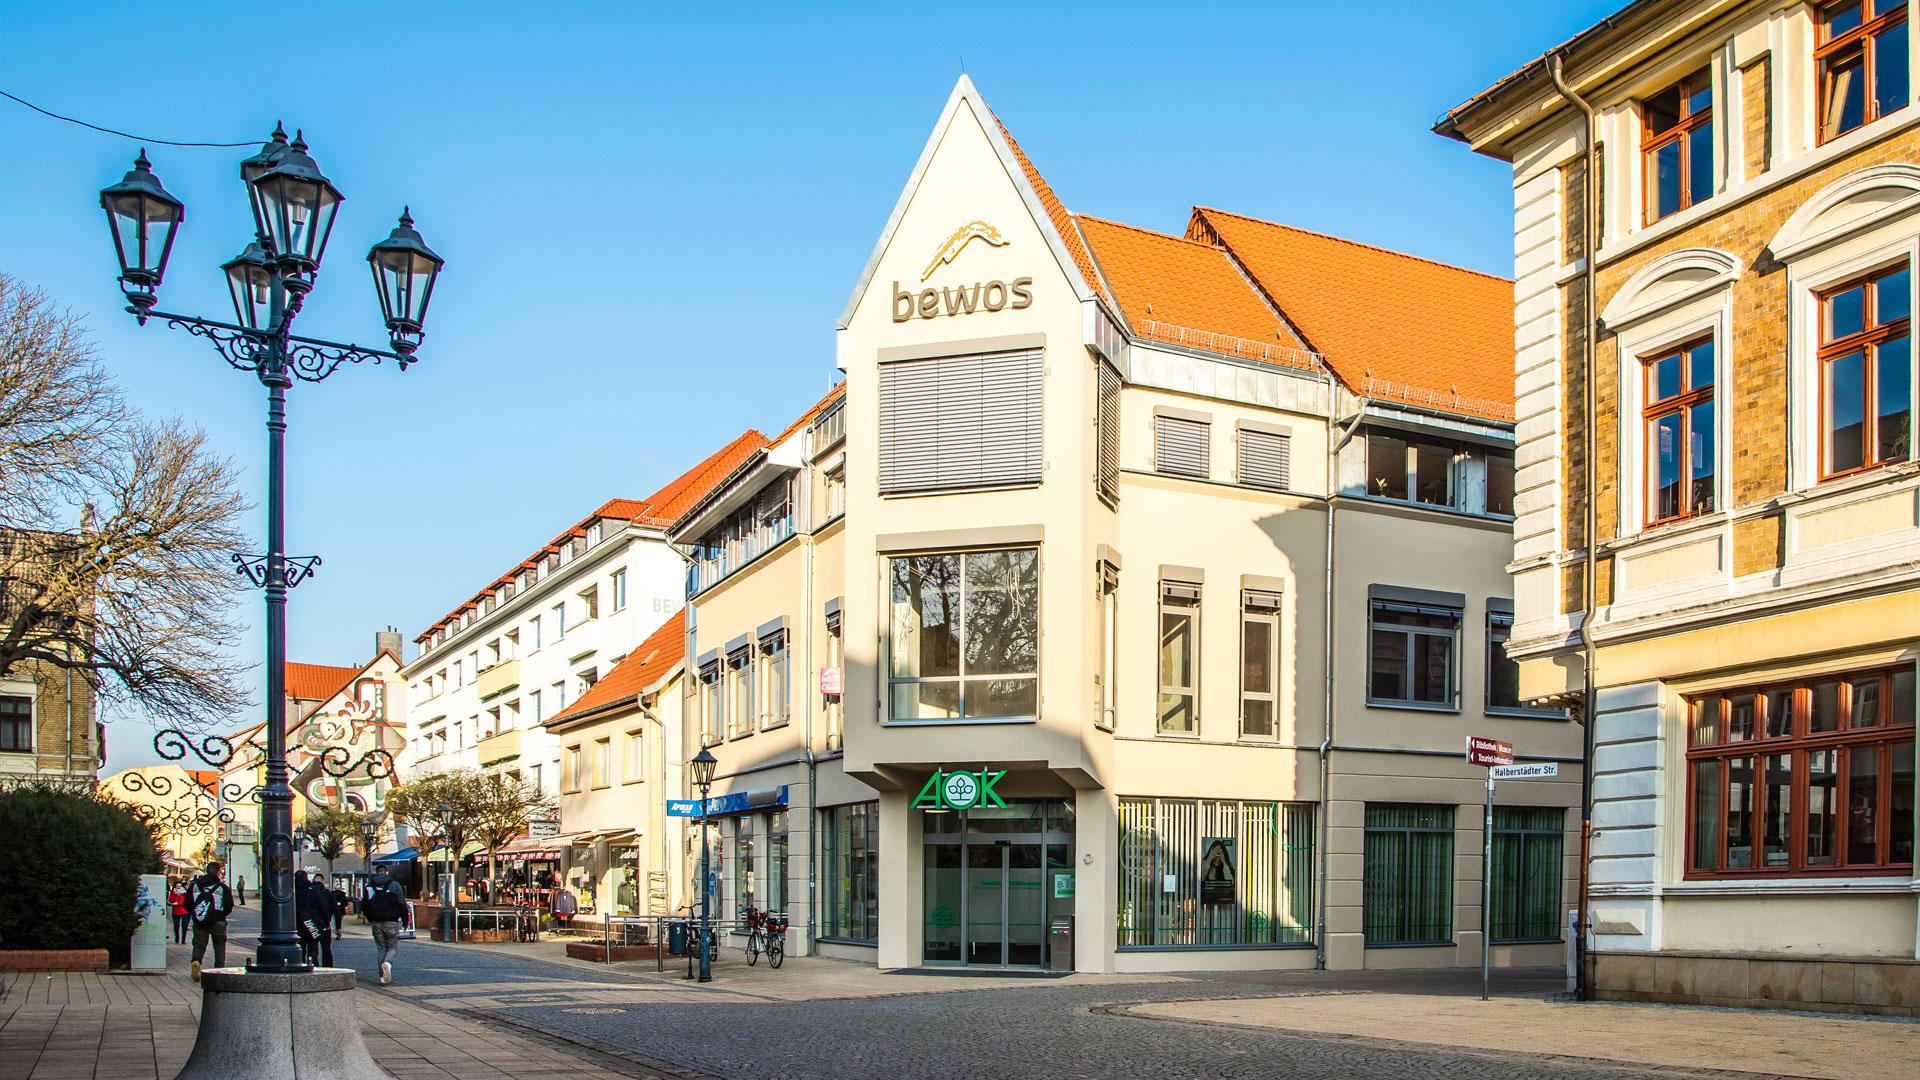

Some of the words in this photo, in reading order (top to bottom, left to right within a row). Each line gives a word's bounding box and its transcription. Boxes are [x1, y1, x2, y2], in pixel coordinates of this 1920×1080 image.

[892, 277, 1033, 323] bewos
[908, 769, 1009, 812] AOK
[1495, 766, 1541, 776] Halberstädter
[1543, 765, 1556, 775] Str.
